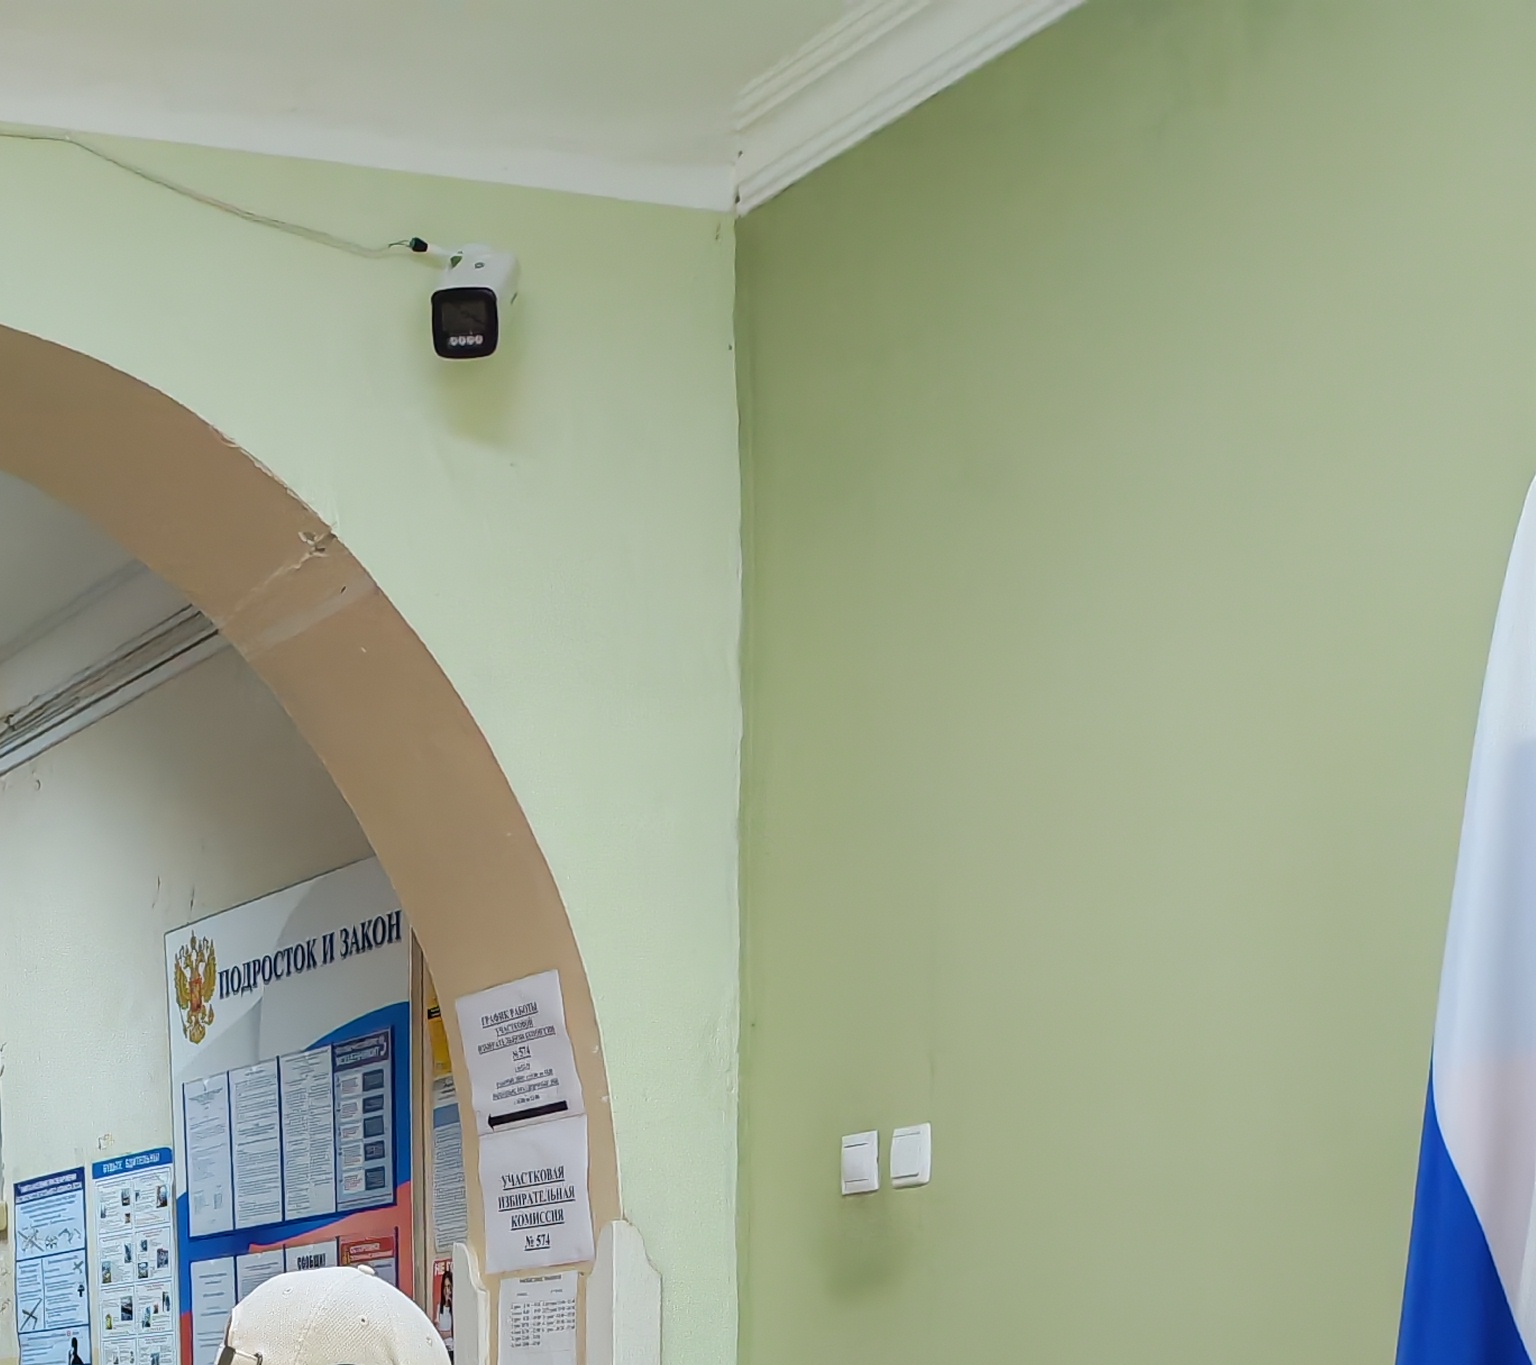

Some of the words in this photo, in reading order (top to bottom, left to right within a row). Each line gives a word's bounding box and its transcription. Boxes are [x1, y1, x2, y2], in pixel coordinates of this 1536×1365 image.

[218, 938, 318, 1000] ПОДРОСТОК
[322, 931, 335, 966] И
[340, 910, 402, 960] ЗАКОН
[481, 1010, 509, 1027] ГРАФИК
[510, 1001, 539, 1020] РАБОТЫ
[519, 1045, 531, 1058] 574
[501, 1165, 565, 1189] УЧАСТКОВАЯ
[497, 1185, 575, 1210] ИЗБИРАТЕЛЬНАЯ
[510, 1208, 565, 1228] КОМИССИЯ
[524, 1235, 535, 1249] №
[536, 1233, 550, 1247] 574
